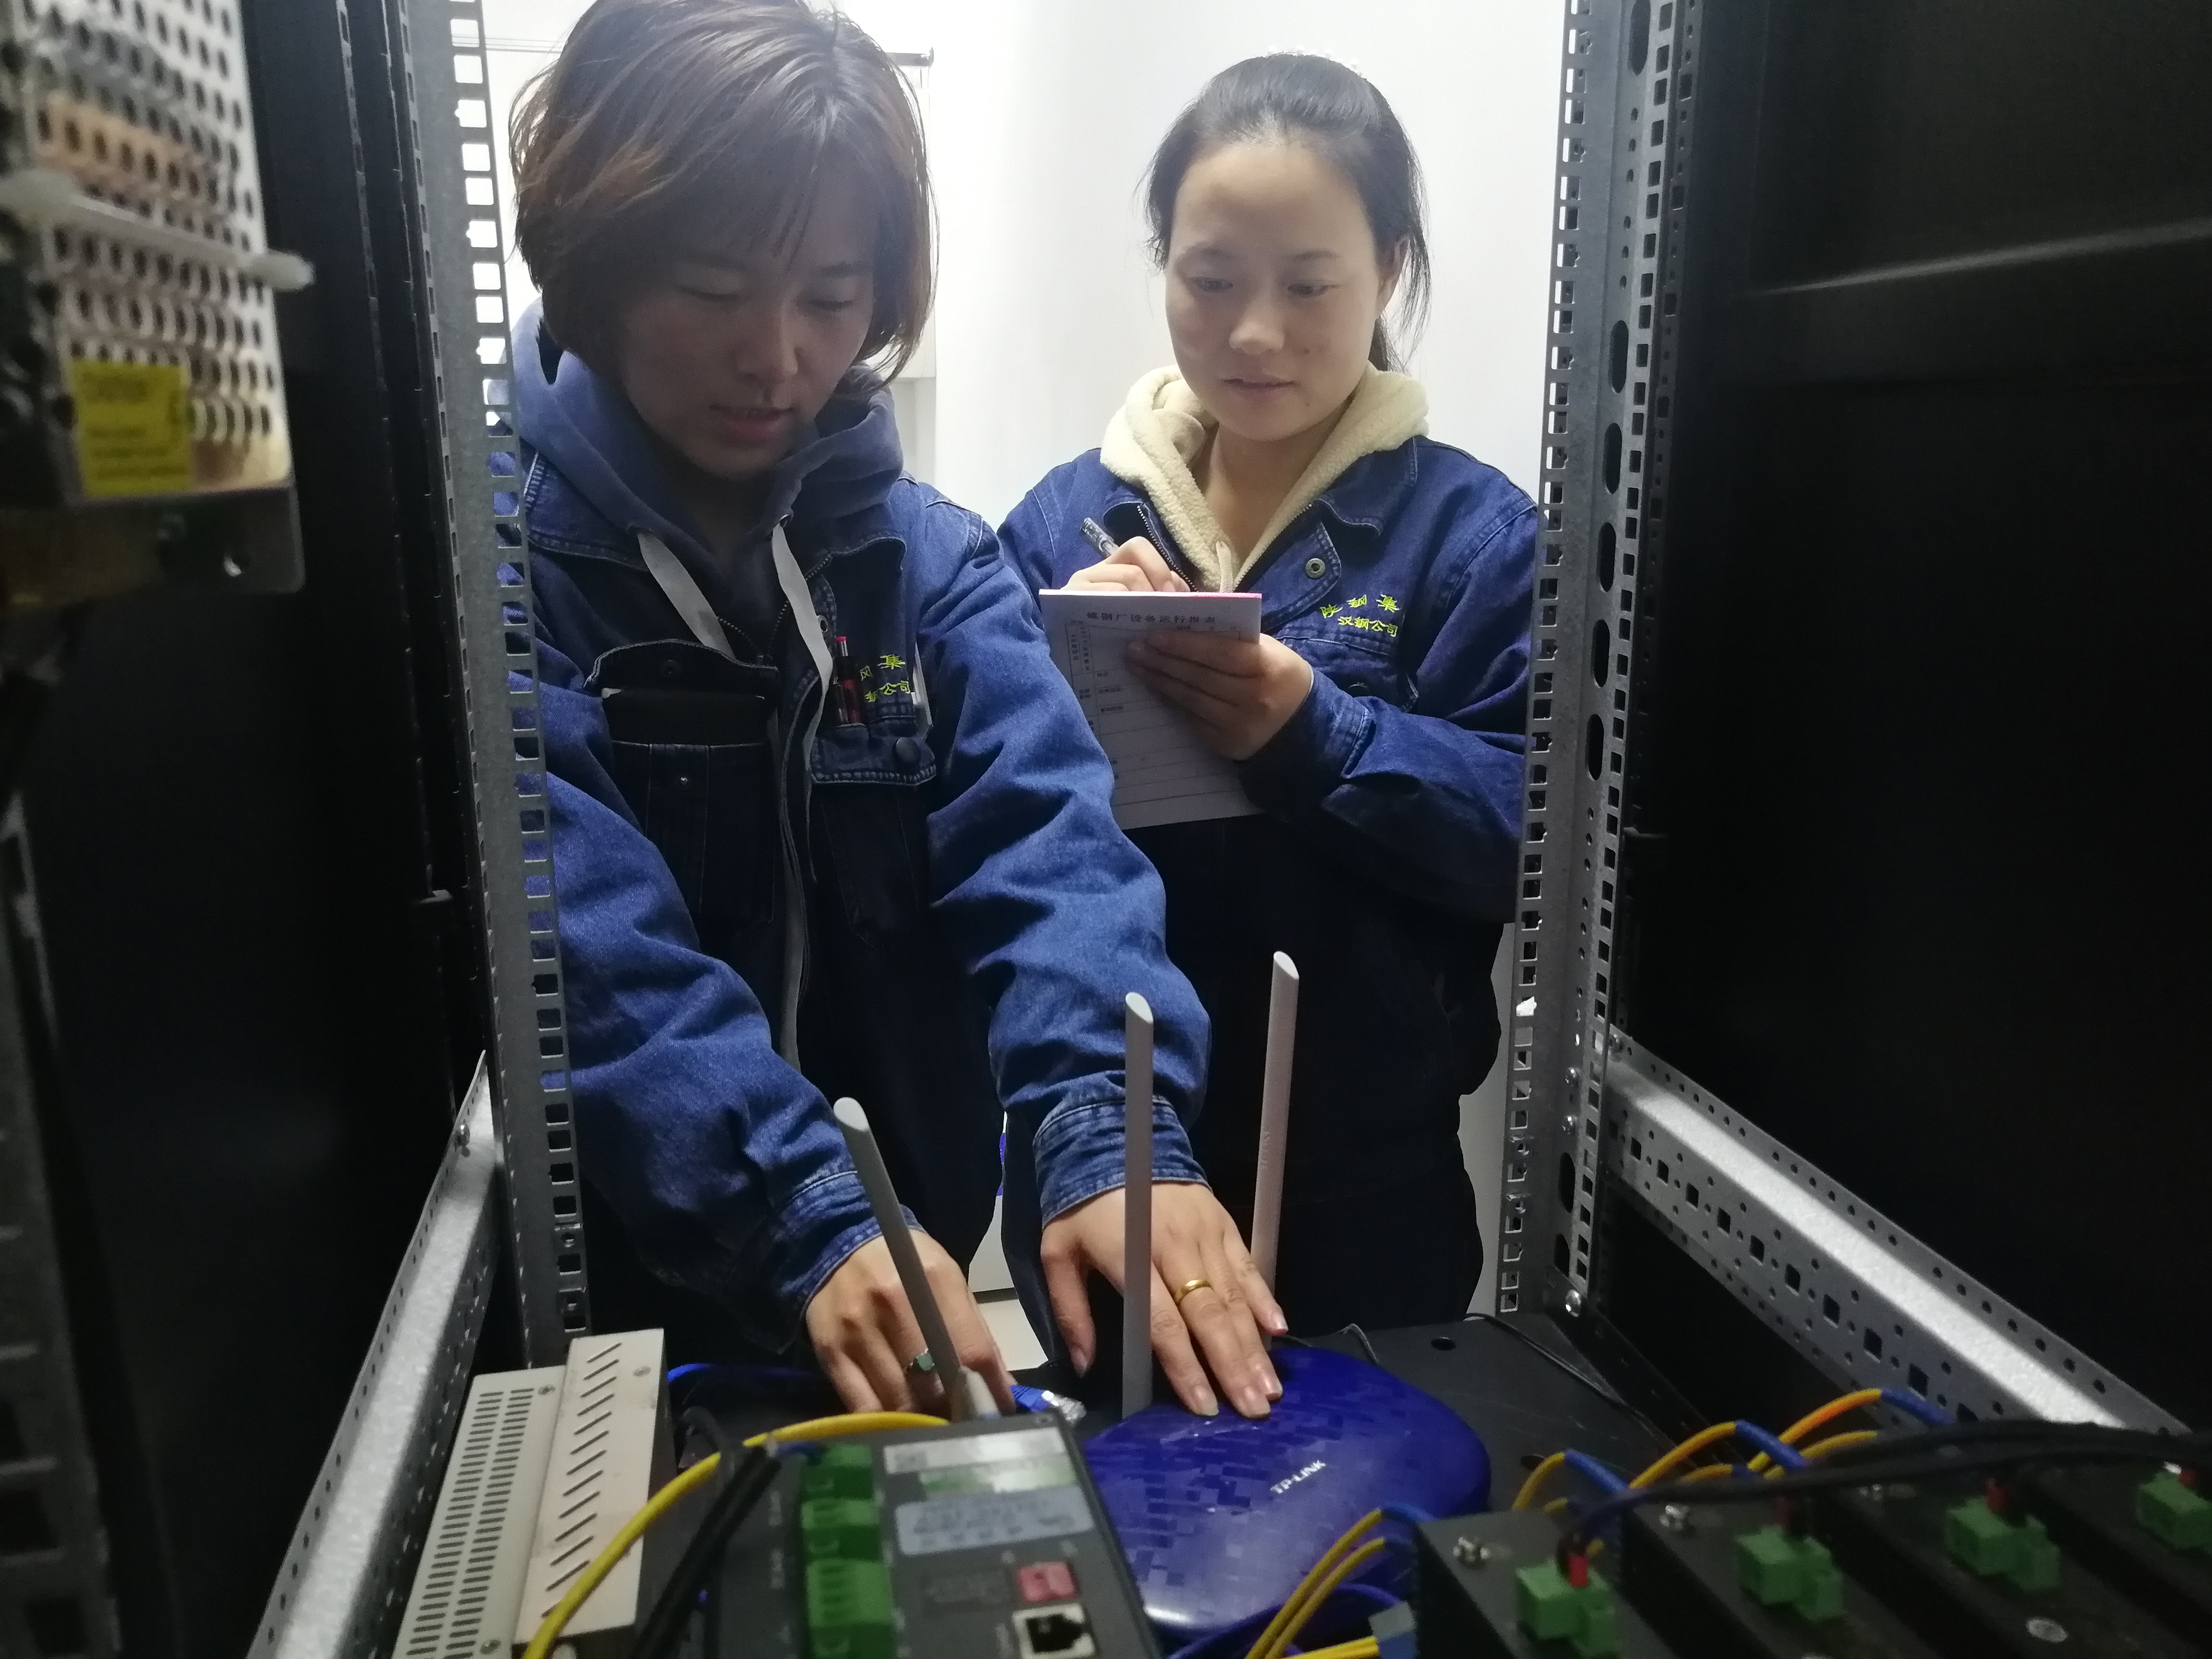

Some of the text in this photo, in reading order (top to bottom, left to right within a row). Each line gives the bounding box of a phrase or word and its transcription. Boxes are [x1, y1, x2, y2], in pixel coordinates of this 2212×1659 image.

[1337, 616, 1398, 637] 汉钢公司
[1270, 1459, 1326, 1494] TP-LINK
